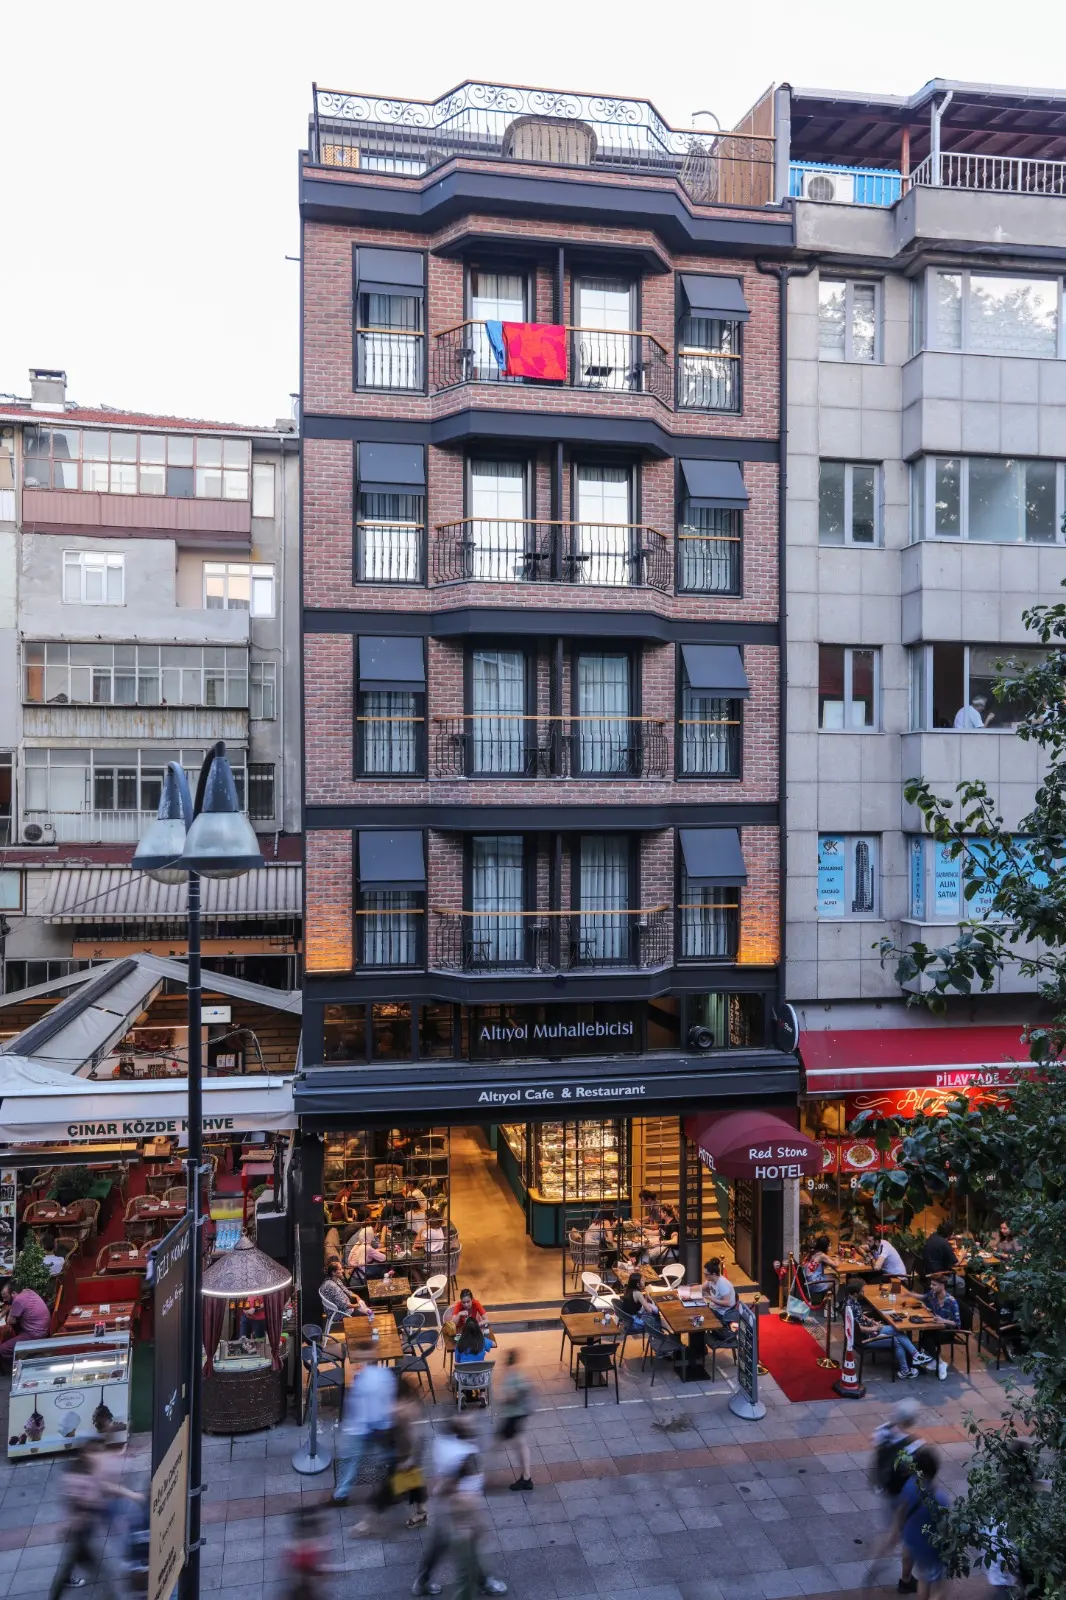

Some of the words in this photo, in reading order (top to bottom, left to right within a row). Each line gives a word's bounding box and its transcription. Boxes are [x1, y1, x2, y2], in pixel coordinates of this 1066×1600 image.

[480, 1024, 528, 1042] Altıyol
[533, 1021, 633, 1039] Muhallebicisi
[478, 1090, 521, 1104] Altıyol
[525, 1088, 554, 1100] Cafe
[561, 1087, 572, 1098] &
[576, 1084, 646, 1097] Restaurant
[67, 1124, 118, 1138] ÇINAR
[122, 1120, 177, 1135] KÖZDE
[181, 1118, 234, 1132] KHVE
[698, 1145, 716, 1170] HOTEL
[749, 1146, 773, 1160] Red
[777, 1147, 808, 1158] Stone
[755, 1164, 805, 1179] HOTEL
